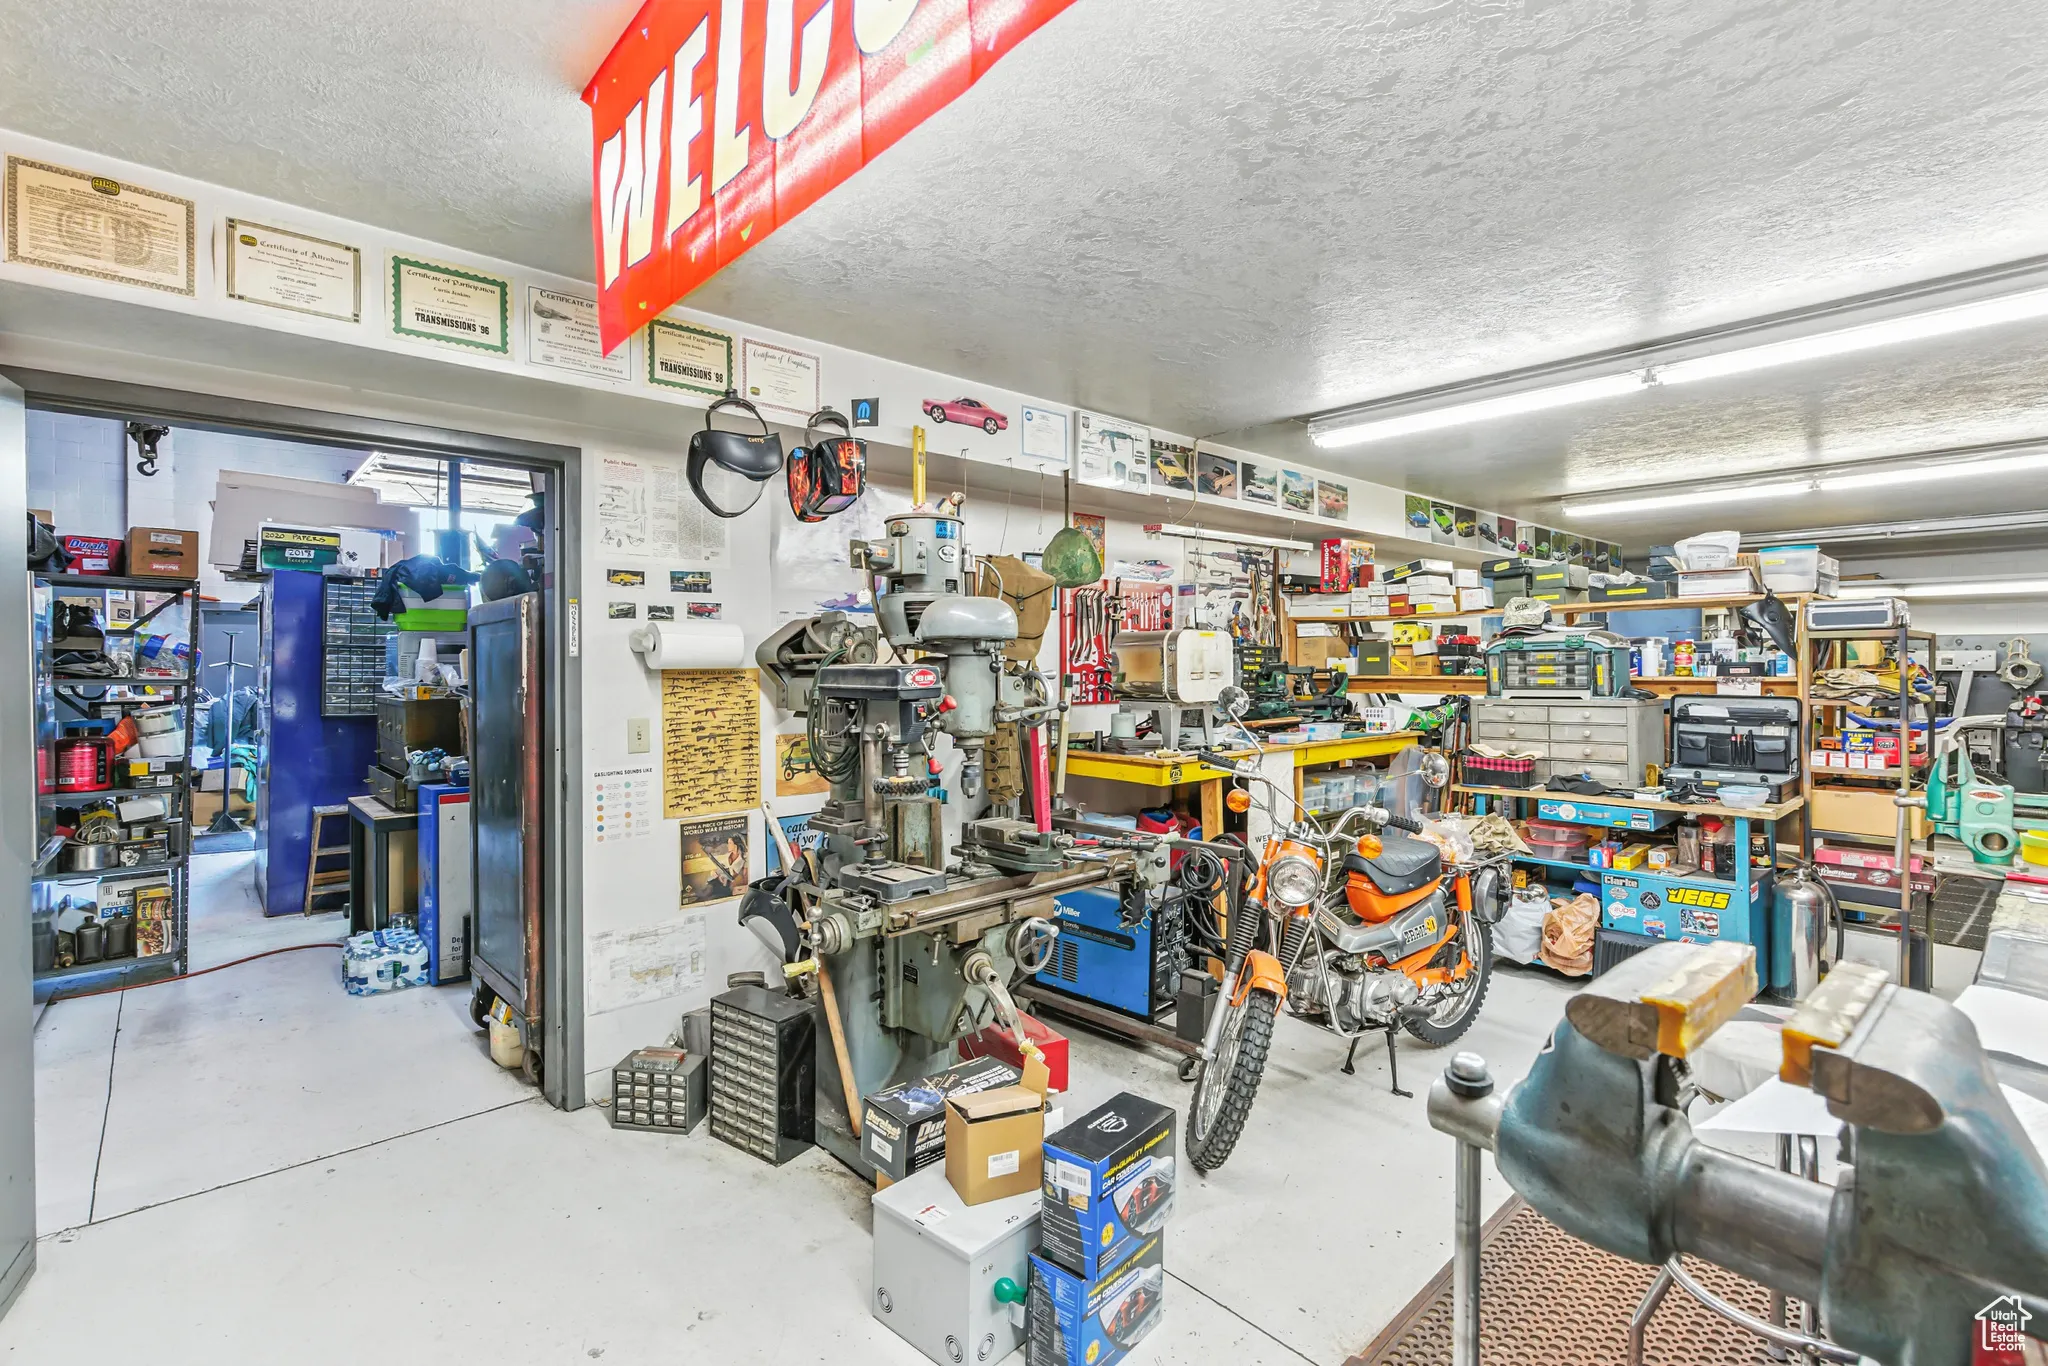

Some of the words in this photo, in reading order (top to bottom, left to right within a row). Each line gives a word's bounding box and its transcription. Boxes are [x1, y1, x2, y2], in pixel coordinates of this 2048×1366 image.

[600, 0, 924, 291] WELC
[260, 240, 298, 254] Certificate
[310, 251, 350, 266] Attendance
[406, 269, 441, 282] Certificate
[452, 279, 496, 295] Participation
[540, 290, 585, 307] CERTIFICATE
[414, 312, 476, 332] TRANSMISSIONS
[478, 324, 490, 335] '96
[658, 328, 685, 339] Certificate
[693, 336, 724, 348] Participation
[751, 348, 776, 361] Certificate
[778, 355, 784, 364] of
[787, 356, 811, 371] Completion
[660, 361, 712, 381] TRANSMISSIONS
[714, 372, 724, 383] '98
[293, 534, 326, 542] PAPERS
[792, 833, 801, 843] if
[1604, 875, 1638, 888] Clarke
[1820, 867, 1858, 879] Traditions
[1667, 888, 1731, 909] JEGS
[1063, 906, 1080, 917] Miller
[1319, 914, 1338, 932] HONDA
[1404, 925, 1427, 943] TRAIL
[1426, 917, 1436, 932] 90
[866, 1108, 901, 1135] Duralast
[1103, 1147, 1143, 1180] HIGH-QUALITY
[1144, 1128, 1169, 1152] PREMIUM
[1102, 1178, 1115, 1190] CAR
[1115, 1163, 1135, 1182] COVER
[1088, 1260, 1131, 1298] HIGH-QUALITY
[1132, 1236, 1158, 1264] PREMIUM
[1088, 1294, 1102, 1308] CAR
[1102, 1277, 1123, 1298] COVER
